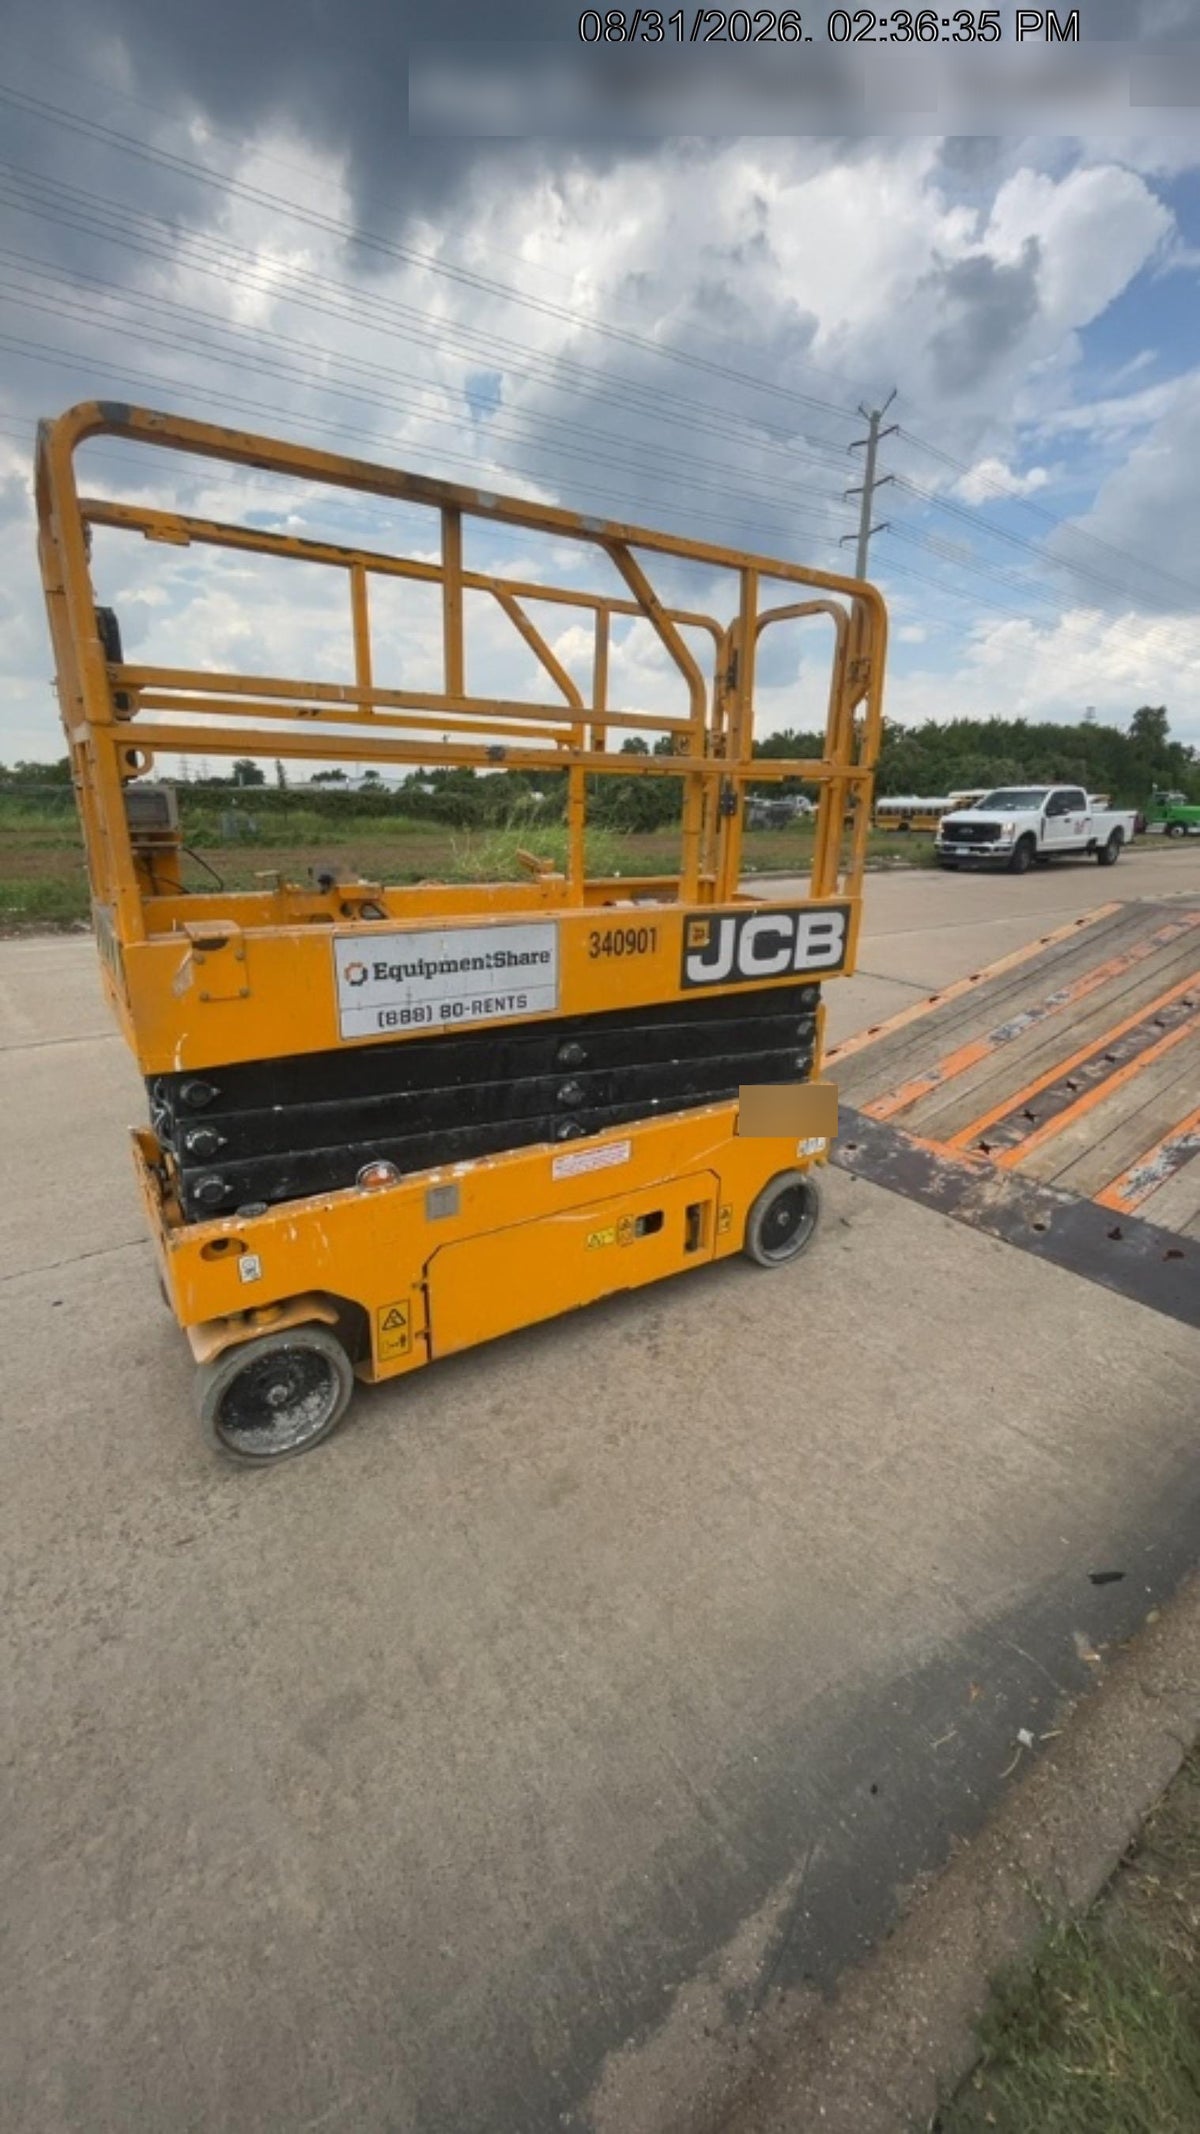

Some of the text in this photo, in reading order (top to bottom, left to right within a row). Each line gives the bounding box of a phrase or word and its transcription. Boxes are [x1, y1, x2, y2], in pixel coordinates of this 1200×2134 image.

[589, 927, 657, 959] 340901
[686, 912, 845, 982] JCB
[373, 949, 551, 982] EquipmentShare
[378, 995, 528, 1028] (888) 80-RENTS
